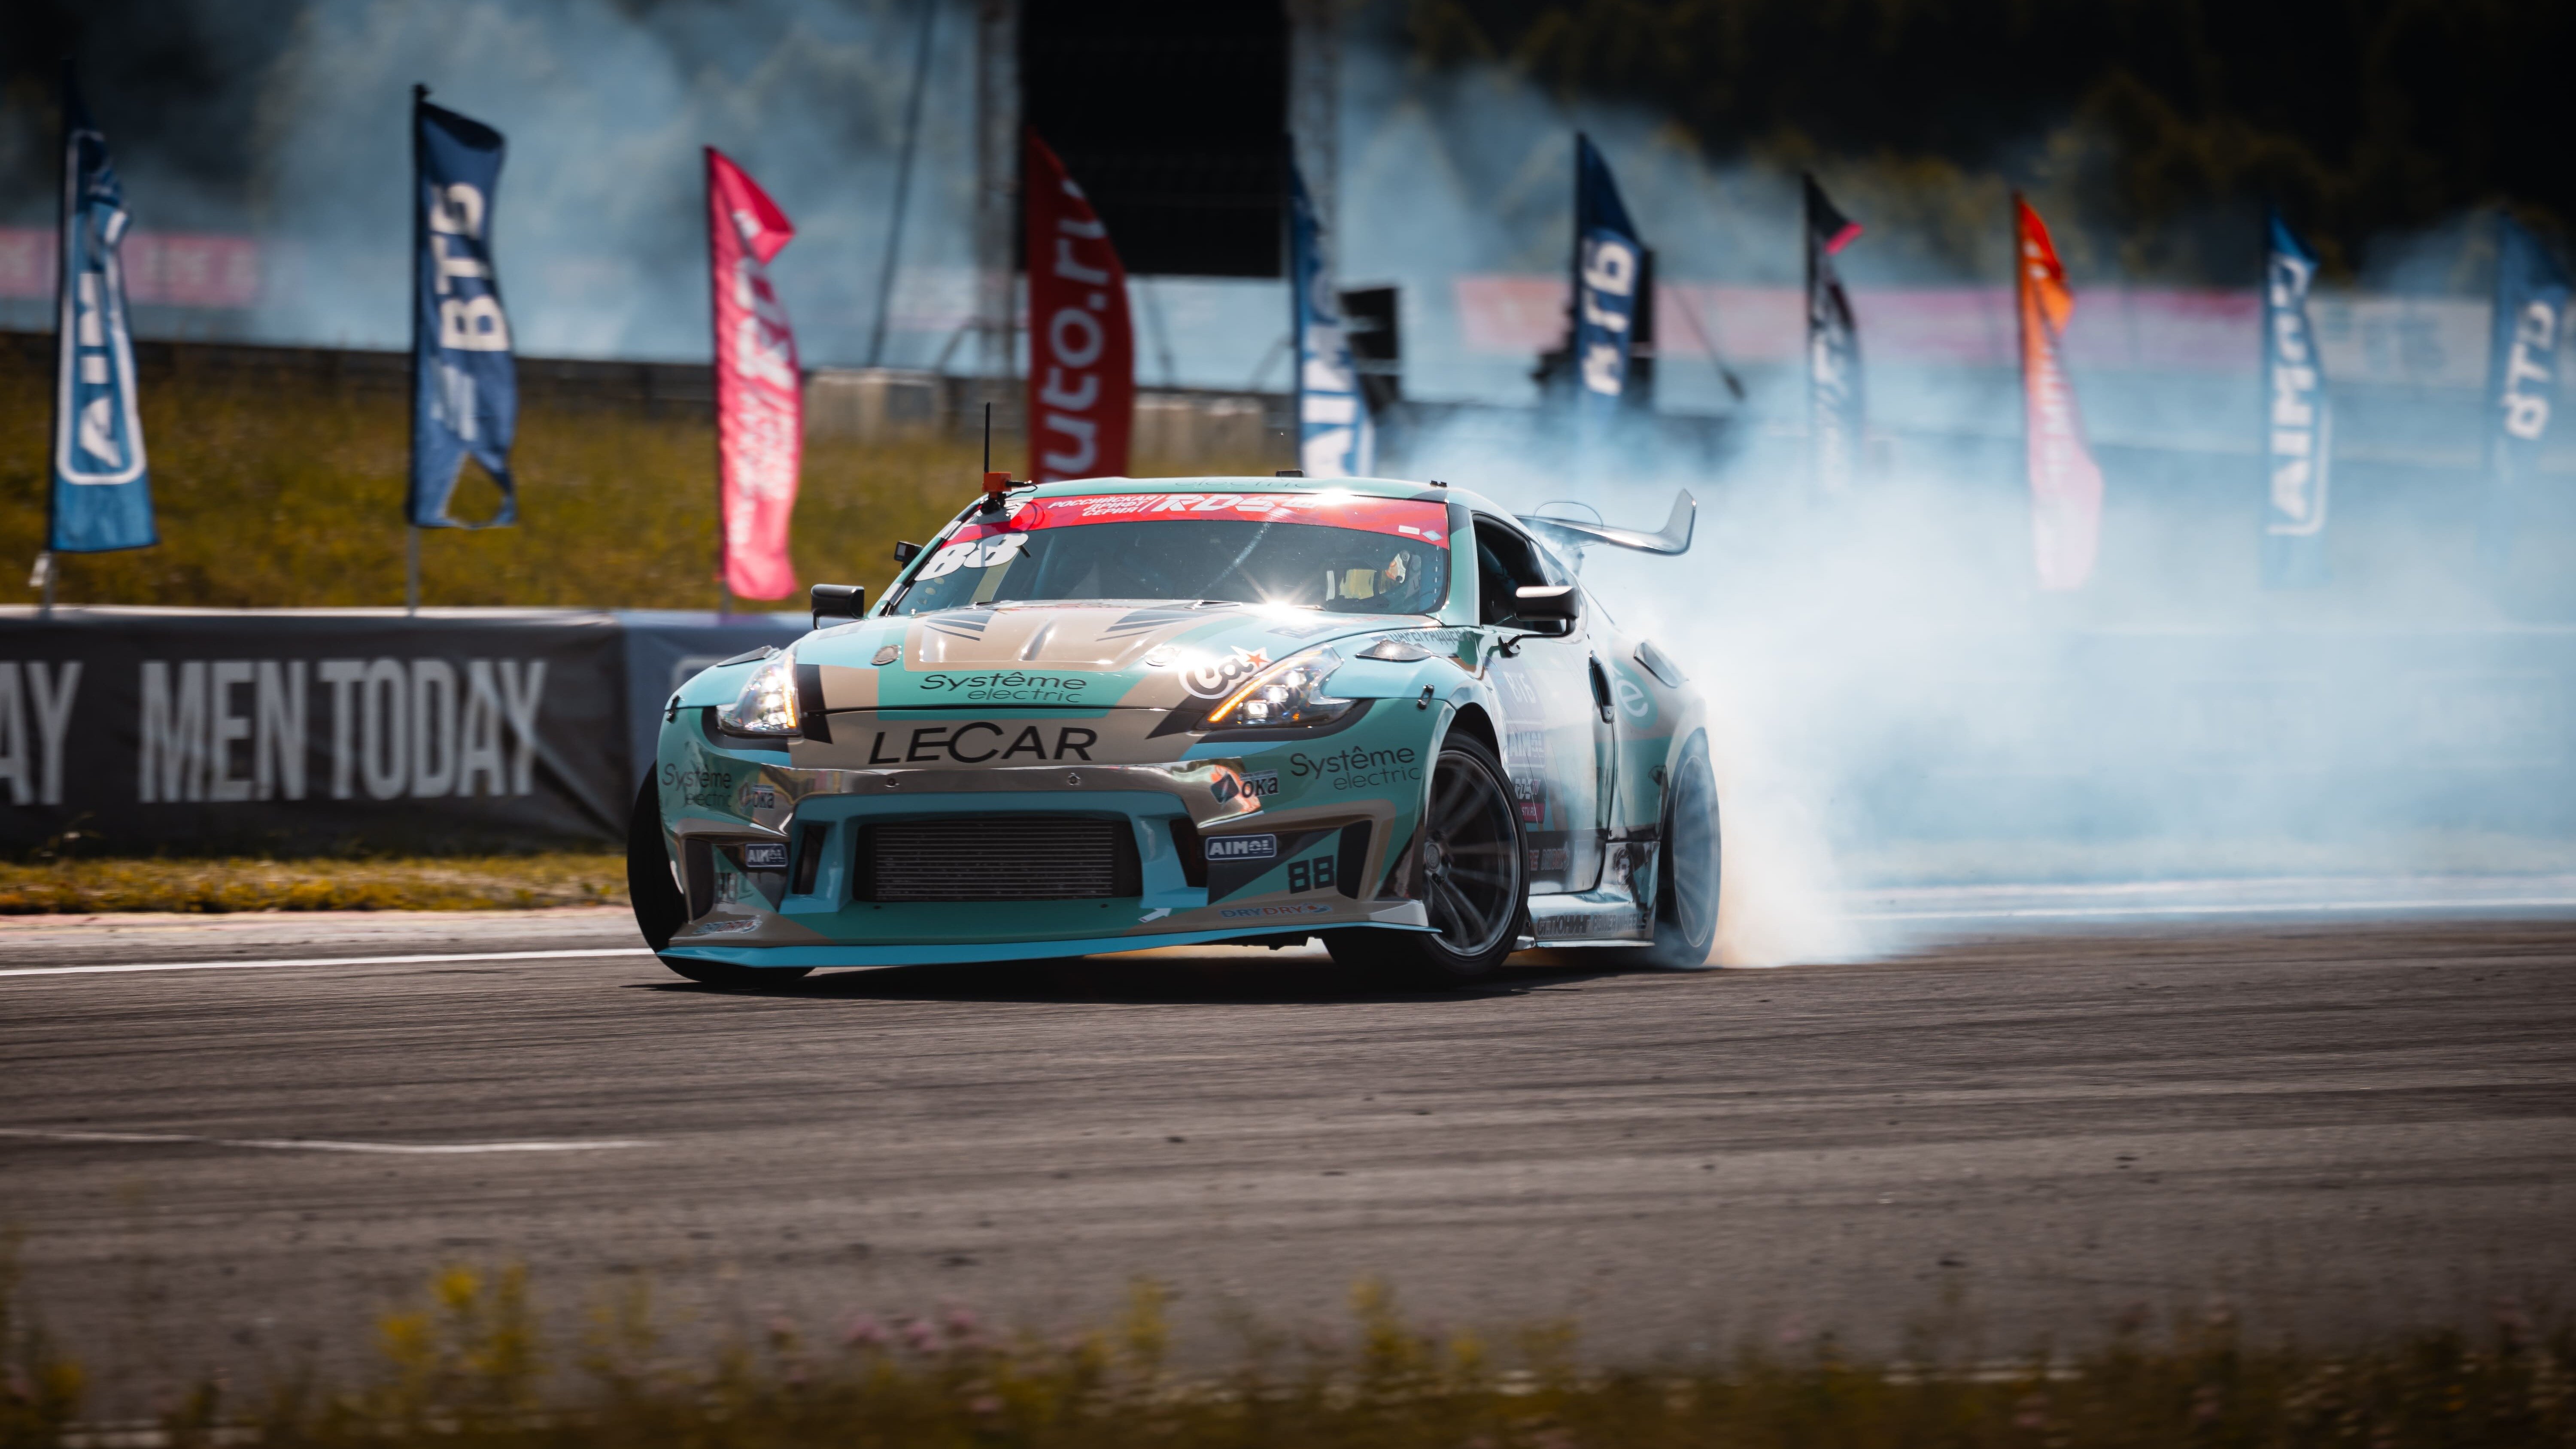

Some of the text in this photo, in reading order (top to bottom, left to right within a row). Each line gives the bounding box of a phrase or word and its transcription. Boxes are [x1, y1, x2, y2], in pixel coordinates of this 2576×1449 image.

[1048, 495, 1158, 508] РОССИЙСКАЯ
[1083, 501, 1149, 511] ДРИФТ
[1151, 495, 1290, 512] RDS
[1082, 507, 1139, 516] СЕРИЯ
[914, 533, 1029, 581] 88
[920, 671, 1087, 691] Systême
[967, 688, 1082, 703] electric
[140, 658, 547, 802] MEN TODAY
[869, 722, 1097, 764] LECAR
[1290, 746, 1415, 779] Systême
[1334, 767, 1422, 791] electric
[1522, 806, 1537, 817] STV.RU
[1208, 838, 1273, 856] AIMOL
[1288, 856, 1335, 894] 88
[1221, 905, 1303, 918] DRYDRY
